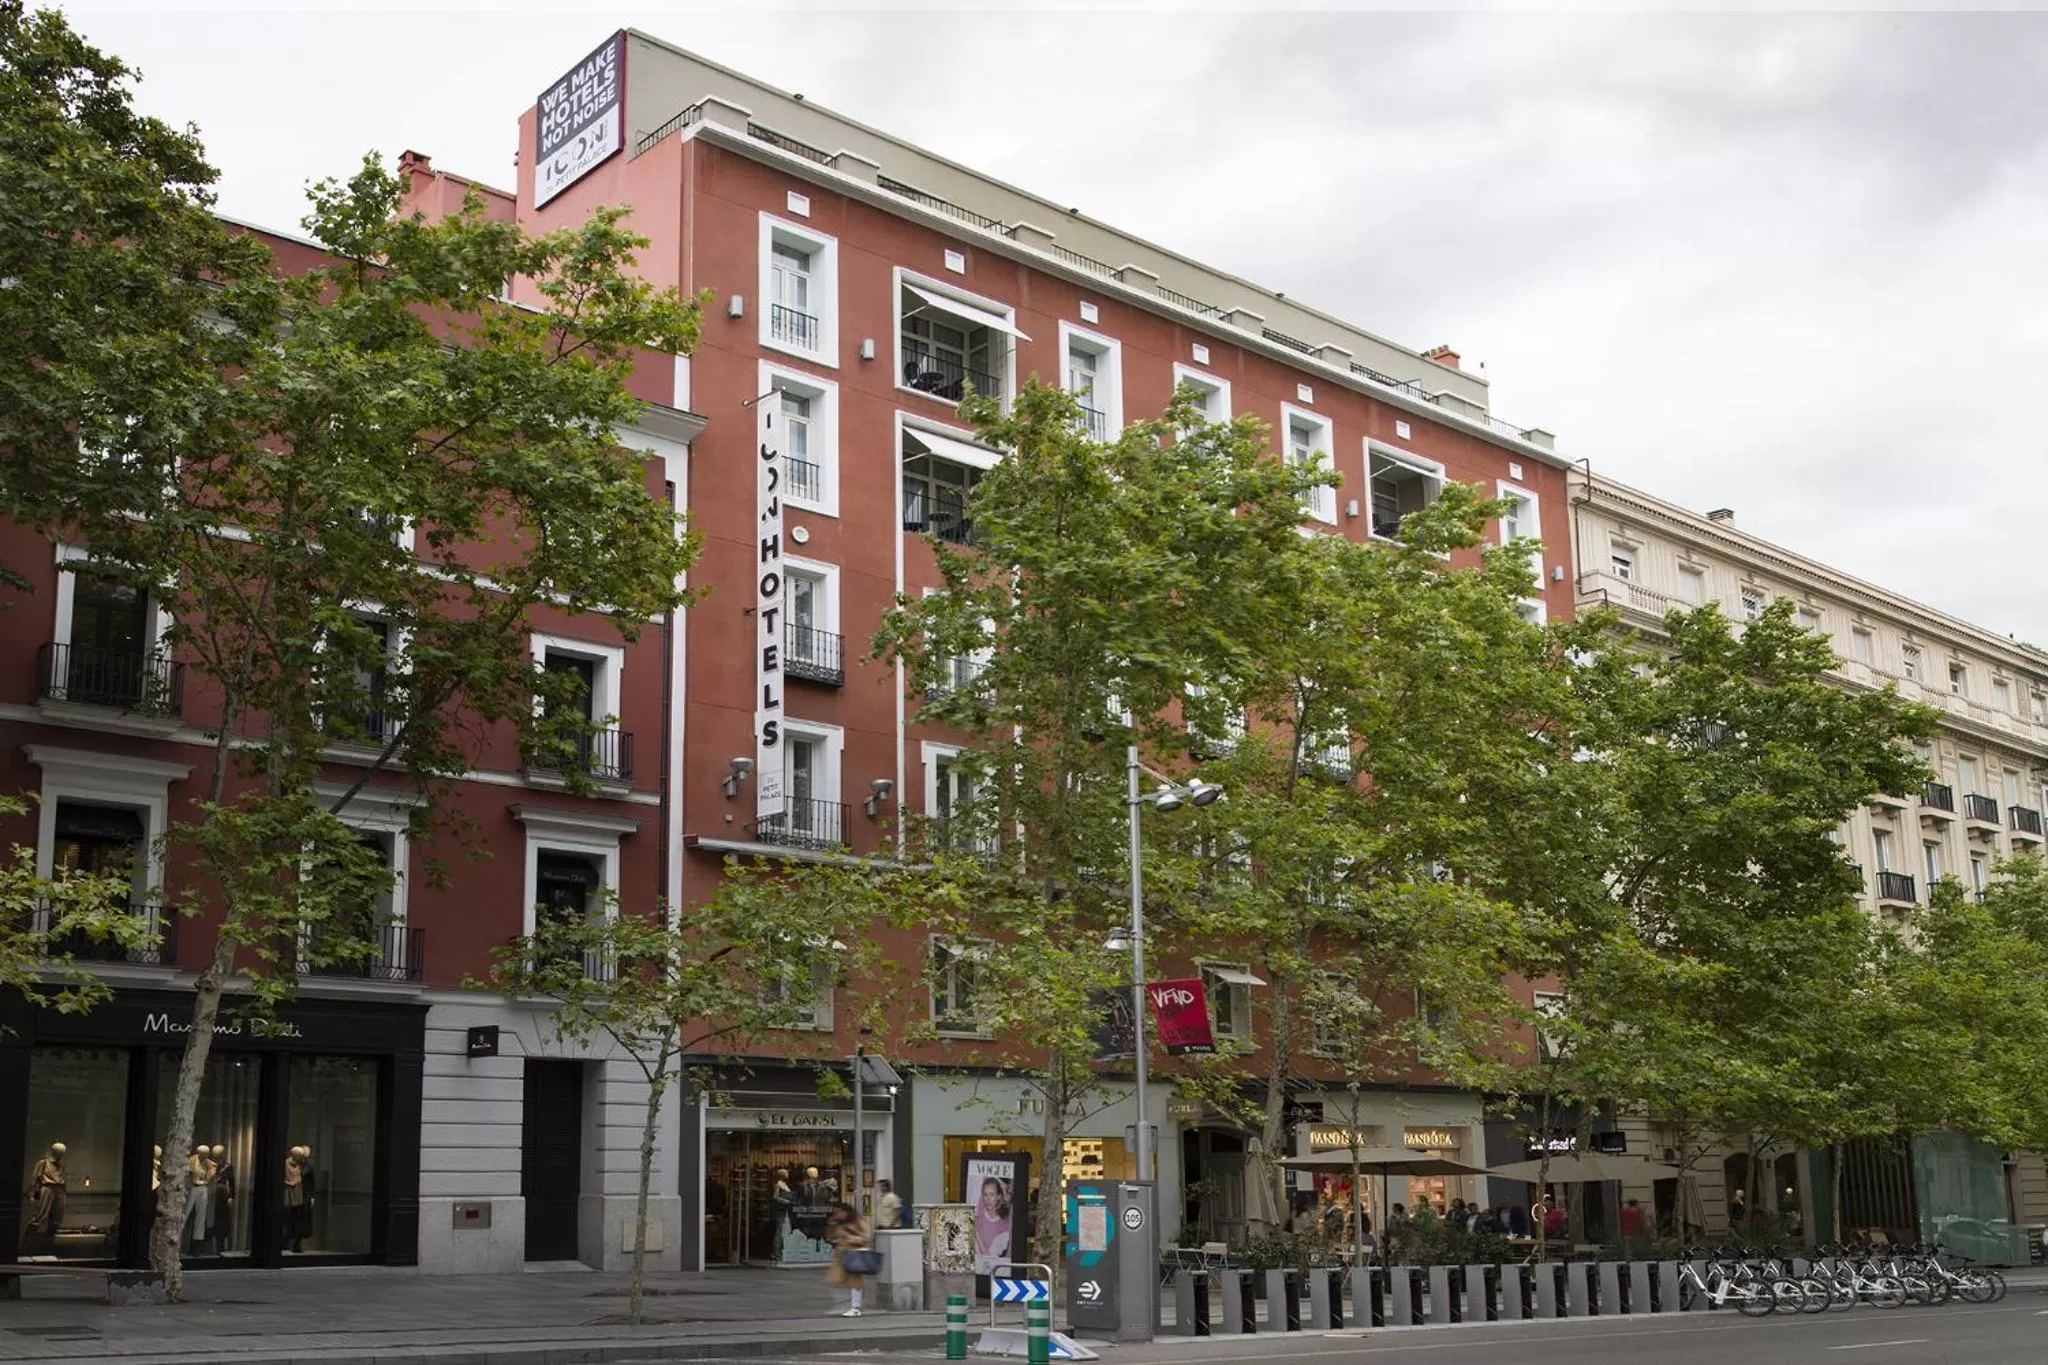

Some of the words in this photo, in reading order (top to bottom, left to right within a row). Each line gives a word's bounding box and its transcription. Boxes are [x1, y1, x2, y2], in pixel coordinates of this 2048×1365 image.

[541, 82, 568, 114] WE
[571, 42, 616, 88] MAKE
[542, 62, 616, 137] HOTELS
[543, 118, 572, 152] NOT
[573, 85, 616, 129] NOISE
[760, 533, 781, 748] HOTELS
[771, 1113, 787, 1125] EL
[1404, 1131, 1453, 1146] PANDORA
[976, 1163, 1011, 1177] VOGUE
[1126, 1214, 1140, 1223] 105
